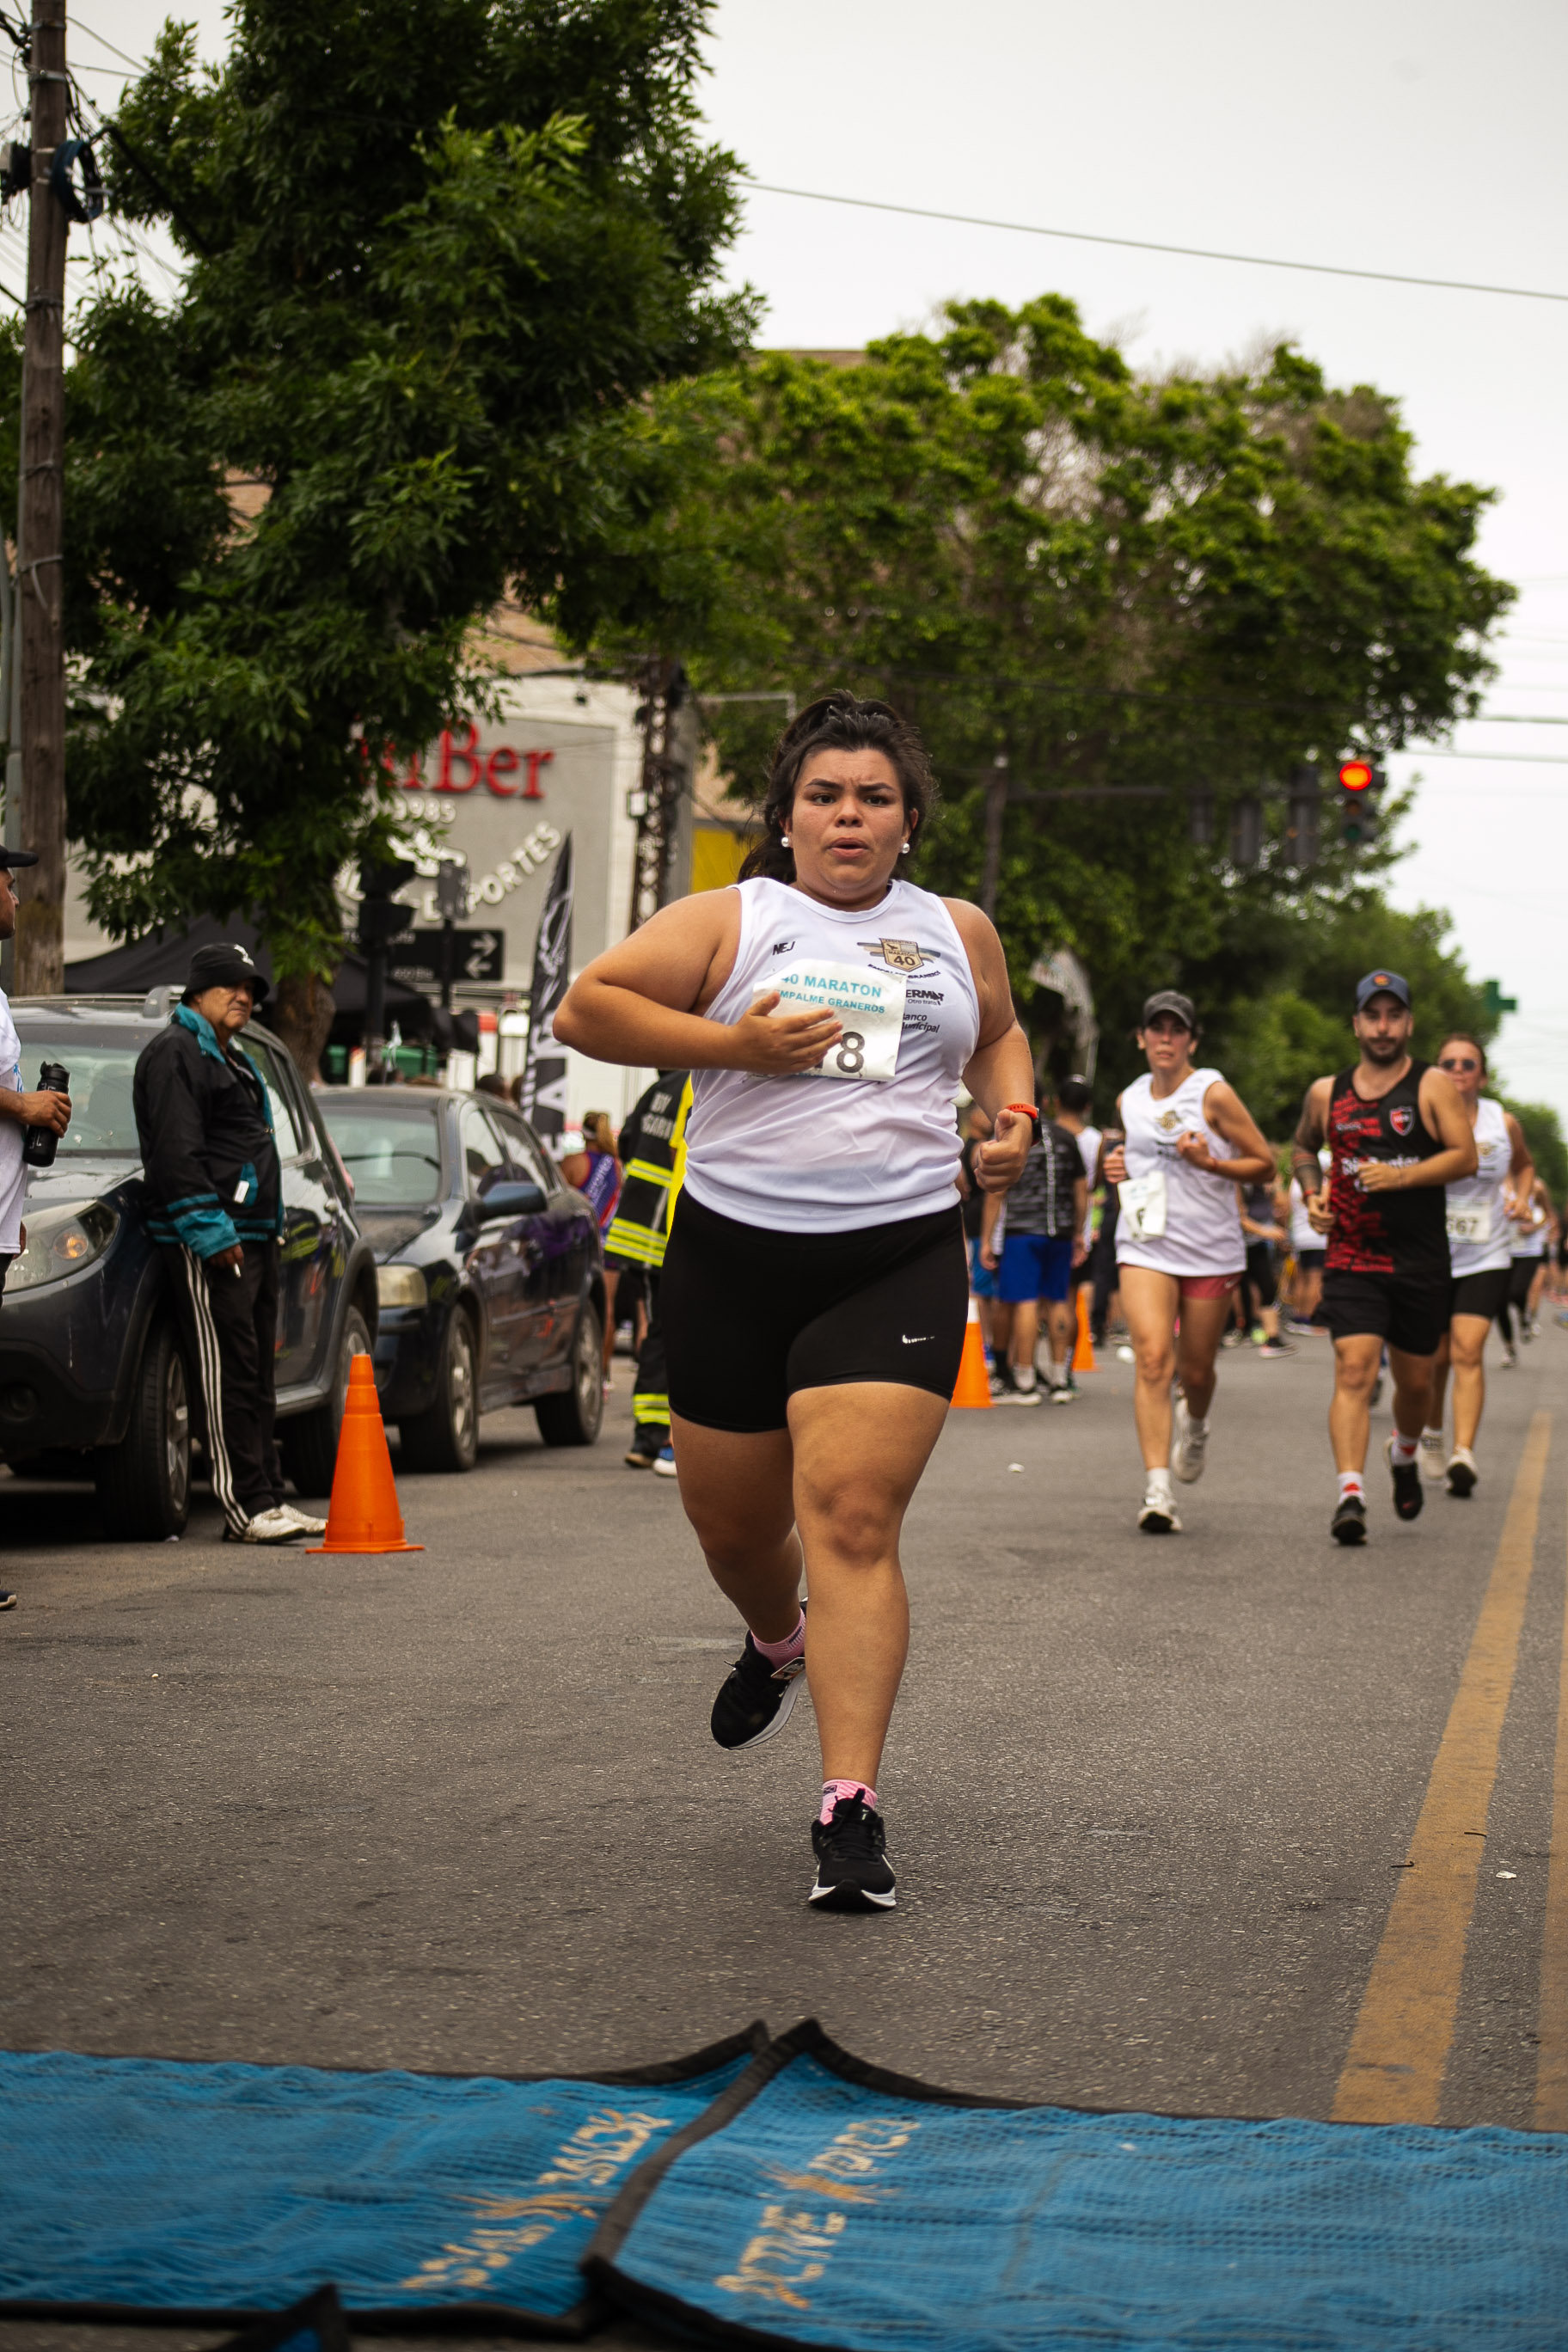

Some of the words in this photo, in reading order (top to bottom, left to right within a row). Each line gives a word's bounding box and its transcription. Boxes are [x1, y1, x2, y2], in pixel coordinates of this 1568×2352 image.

[893, 955, 916, 966] 40
[804, 975, 882, 998] MARATON
[778, 990, 826, 1005] MPALME
[828, 997, 885, 1014] GRANEROS
[902, 1013, 928, 1022] anco
